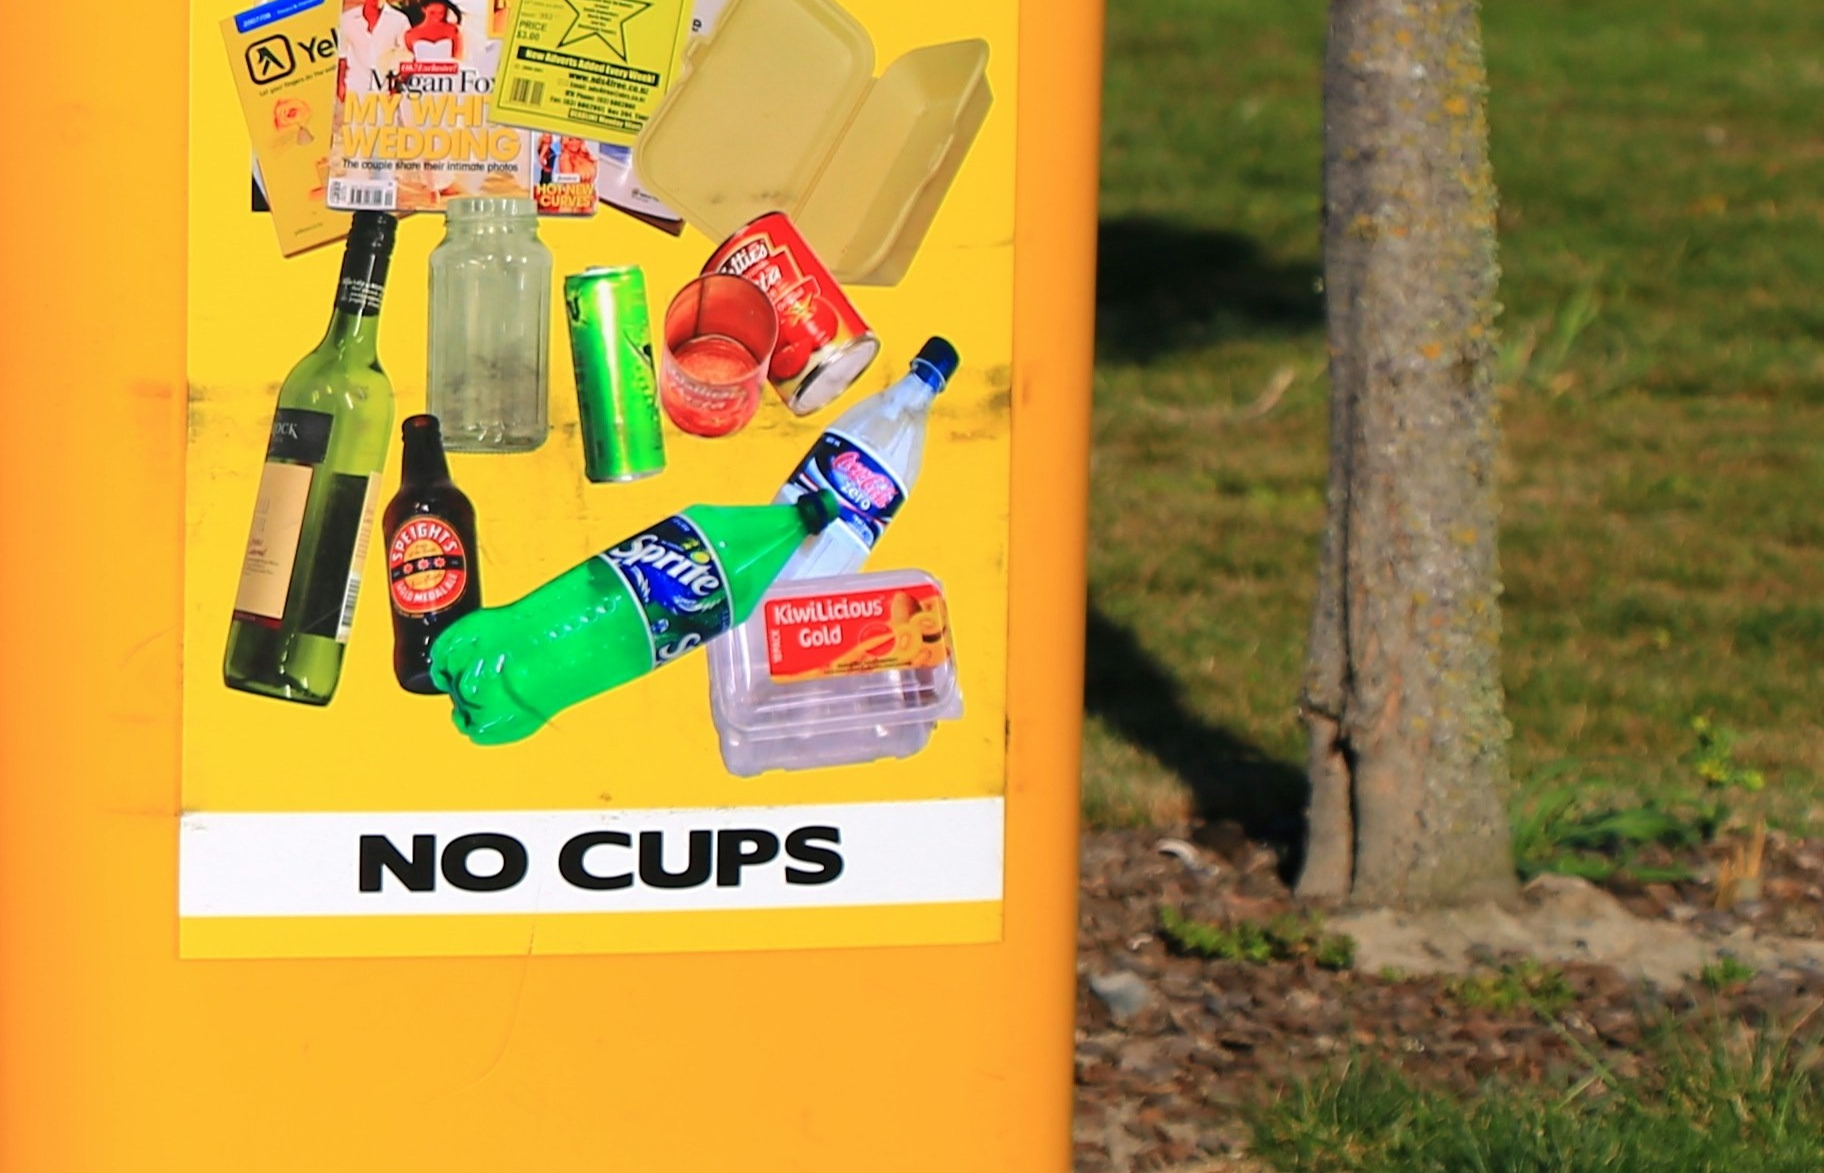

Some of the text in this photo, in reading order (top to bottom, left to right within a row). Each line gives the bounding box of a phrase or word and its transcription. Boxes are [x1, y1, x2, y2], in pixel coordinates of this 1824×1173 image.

[516, 30, 541, 42] $3.00
[518, 19, 548, 32] PRICE
[343, 93, 401, 126] MY
[342, 125, 522, 162] WEDDING
[342, 158, 519, 174] The couple share their intimate photos
[841, 480, 871, 511] zero
[608, 534, 720, 597] Sprite
[774, 598, 884, 625] KiwiLicious
[799, 625, 843, 648] Gold
[358, 825, 846, 893] NO CUPS
